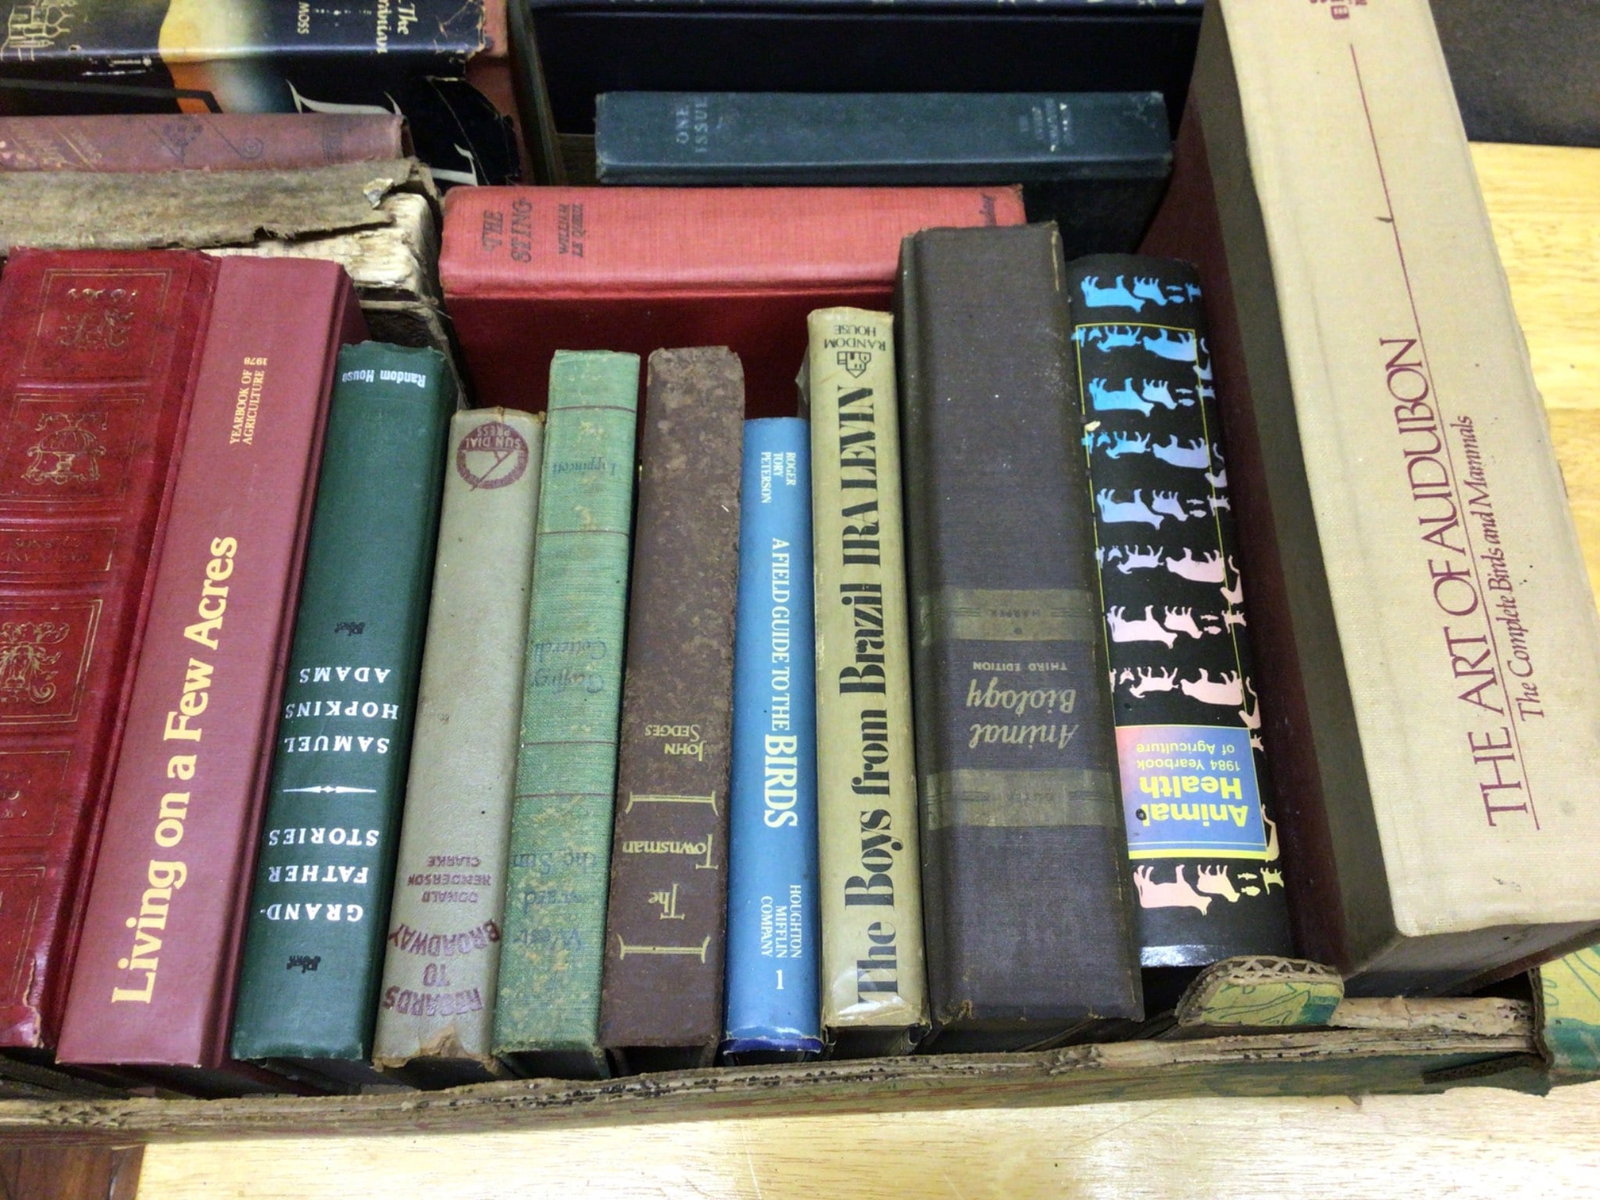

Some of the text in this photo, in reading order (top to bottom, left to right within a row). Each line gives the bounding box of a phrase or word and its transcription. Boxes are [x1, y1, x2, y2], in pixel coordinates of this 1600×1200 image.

[397, 3, 419, 35] The
[676, 105, 690, 145] ONE
[482, 209, 503, 252] THE
[511, 197, 533, 264] STING
[833, 324, 877, 336] HOUSE
[824, 338, 886, 352] RANDOM
[244, 356, 268, 367] 1978
[342, 368, 426, 389] Random House
[229, 369, 252, 445] YEARBOOK OF
[242, 370, 265, 446] AGRICULTURE
[466, 437, 522, 449] SUN DIAL
[476, 426, 511, 437] PRESS
[773, 452, 784, 477] TORY
[785, 452, 797, 486] ROGER
[761, 452, 772, 504] PETERSON
[1450, 415, 1545, 722] The Complete Birds and Mammals
[1379, 337, 1528, 827] THE ART OF AUDUBON
[299, 667, 390, 684] ADAMS
[972, 661, 1068, 673] THIRD EDITION
[764, 538, 798, 829] A FIELD GUIDE TO THE BIRDS
[837, 385, 904, 1005] The Boys from Brazil IRA LEVIN
[966, 676, 1076, 715] Biology
[285, 702, 399, 720] HOPKINS
[284, 736, 389, 754] SAMUEL
[645, 724, 701, 741] SEDGES
[968, 723, 1080, 750] Animal
[664, 741, 706, 762] JOHN
[1136, 740, 1235, 755] of Agriculture
[112, 536, 237, 1004] Living on a Few Acres
[1136, 758, 1241, 771] 1984 Yearbook
[1139, 777, 1243, 800] Health
[1141, 803, 1249, 828] Animal
[268, 829, 379, 846] STORIES
[427, 855, 480, 868] CLARKE
[622, 834, 719, 869] Townsman
[268, 866, 368, 883] FATHER
[407, 873, 492, 887] HENDERSON
[422, 891, 478, 904] DONALD
[648, 883, 685, 920] The
[260, 904, 363, 921] GRAND-
[789, 884, 803, 959] HOUGHTON
[389, 919, 500, 957] BROADWAY
[760, 895, 774, 958] COMPANY
[775, 905, 788, 959] MIFFLIN
[422, 963, 450, 987] TO
[775, 968, 785, 990] 1
[384, 988, 482, 1017] REGARDS
